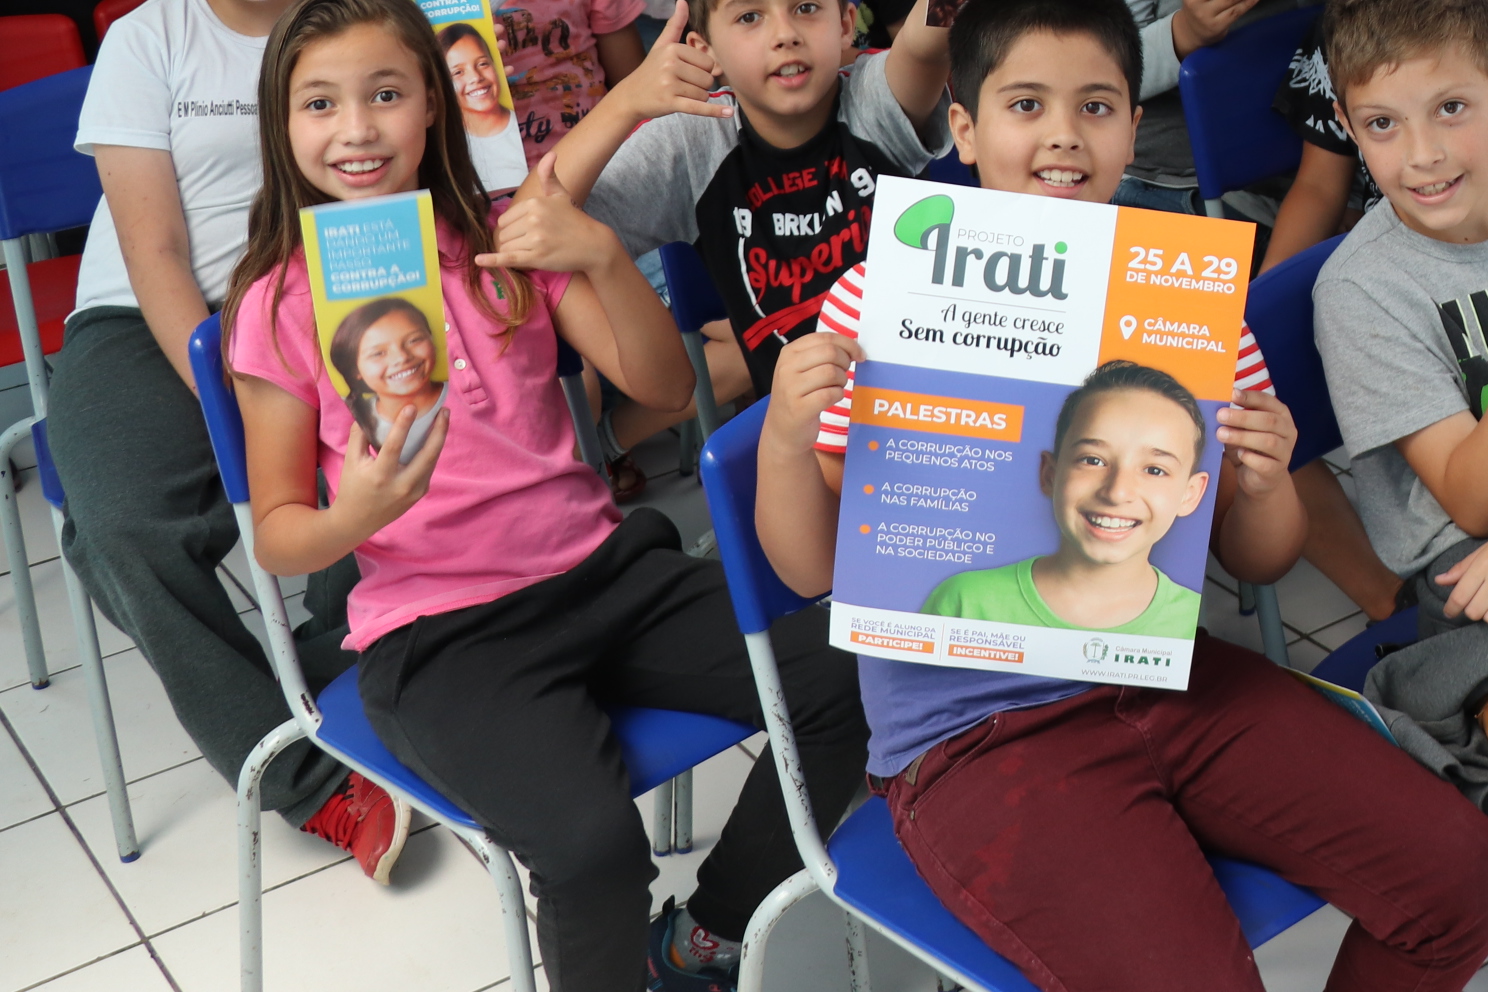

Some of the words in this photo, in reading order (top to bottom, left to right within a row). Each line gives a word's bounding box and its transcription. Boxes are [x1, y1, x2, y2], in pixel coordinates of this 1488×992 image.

[426, 3, 480, 17] ORRUPÇÃO!
[178, 102, 182, 118] E
[184, 101, 190, 118] M
[210, 100, 234, 116] Anciutti
[772, 190, 843, 236] BRKLN
[324, 224, 360, 238] IRATI
[957, 228, 1024, 246] PROJETO
[920, 222, 1069, 301] Irati
[1128, 246, 1163, 271] 25
[1169, 252, 1193, 275] A
[1201, 255, 1237, 279] 29
[330, 267, 386, 281] CONTRA
[389, 263, 400, 273] A
[1126, 270, 1146, 283] DE
[1150, 274, 1234, 293] NOVEMBRO
[332, 271, 419, 293] CORRUPÇÃO!
[941, 304, 956, 321] A
[961, 311, 1007, 327] gente
[1013, 317, 1064, 334] cresce
[1144, 317, 1209, 336] CÂMARA
[899, 319, 944, 343] Sem
[952, 332, 1060, 358] corrupção
[1142, 333, 1225, 352] MUNICIPAL
[874, 399, 1006, 429] PALESTRAS
[885, 438, 895, 448] A
[899, 439, 981, 461] CORRUPÇÃO
[985, 449, 1012, 461] NOS
[886, 450, 958, 467] PEQUENOS
[960, 459, 994, 471] ATOS
[881, 481, 891, 491] A
[894, 483, 976, 504] CORRUPÇÃO
[881, 493, 907, 505] NAS
[910, 492, 969, 511] FAMÍLIAS
[877, 521, 887, 531] A
[890, 523, 972, 544] CORRUPÇÃO
[975, 532, 995, 542] NO
[877, 533, 923, 546] PODER
[926, 534, 983, 552] PÚBLICO
[986, 544, 994, 554] E
[876, 545, 894, 555] NA
[897, 547, 971, 563] SOCIEDADE
[851, 617, 861, 625] SE
[863, 619, 885, 627] VOCÊ
[893, 623, 922, 631] ALUNO
[851, 622, 878, 632] REDE
[880, 627, 934, 639] MUNICIPAL
[858, 634, 922, 649] PARTICIPE!
[949, 632, 1023, 649] RESPONSÁVEL
[970, 630, 988, 640] PAI,
[990, 632, 1009, 641] MÃE
[953, 646, 1018, 660] INCENTIVE!
[1114, 654, 1170, 666] IRATI
[1115, 645, 1140, 653] Câmara
[1141, 647, 1172, 656] Municipal
